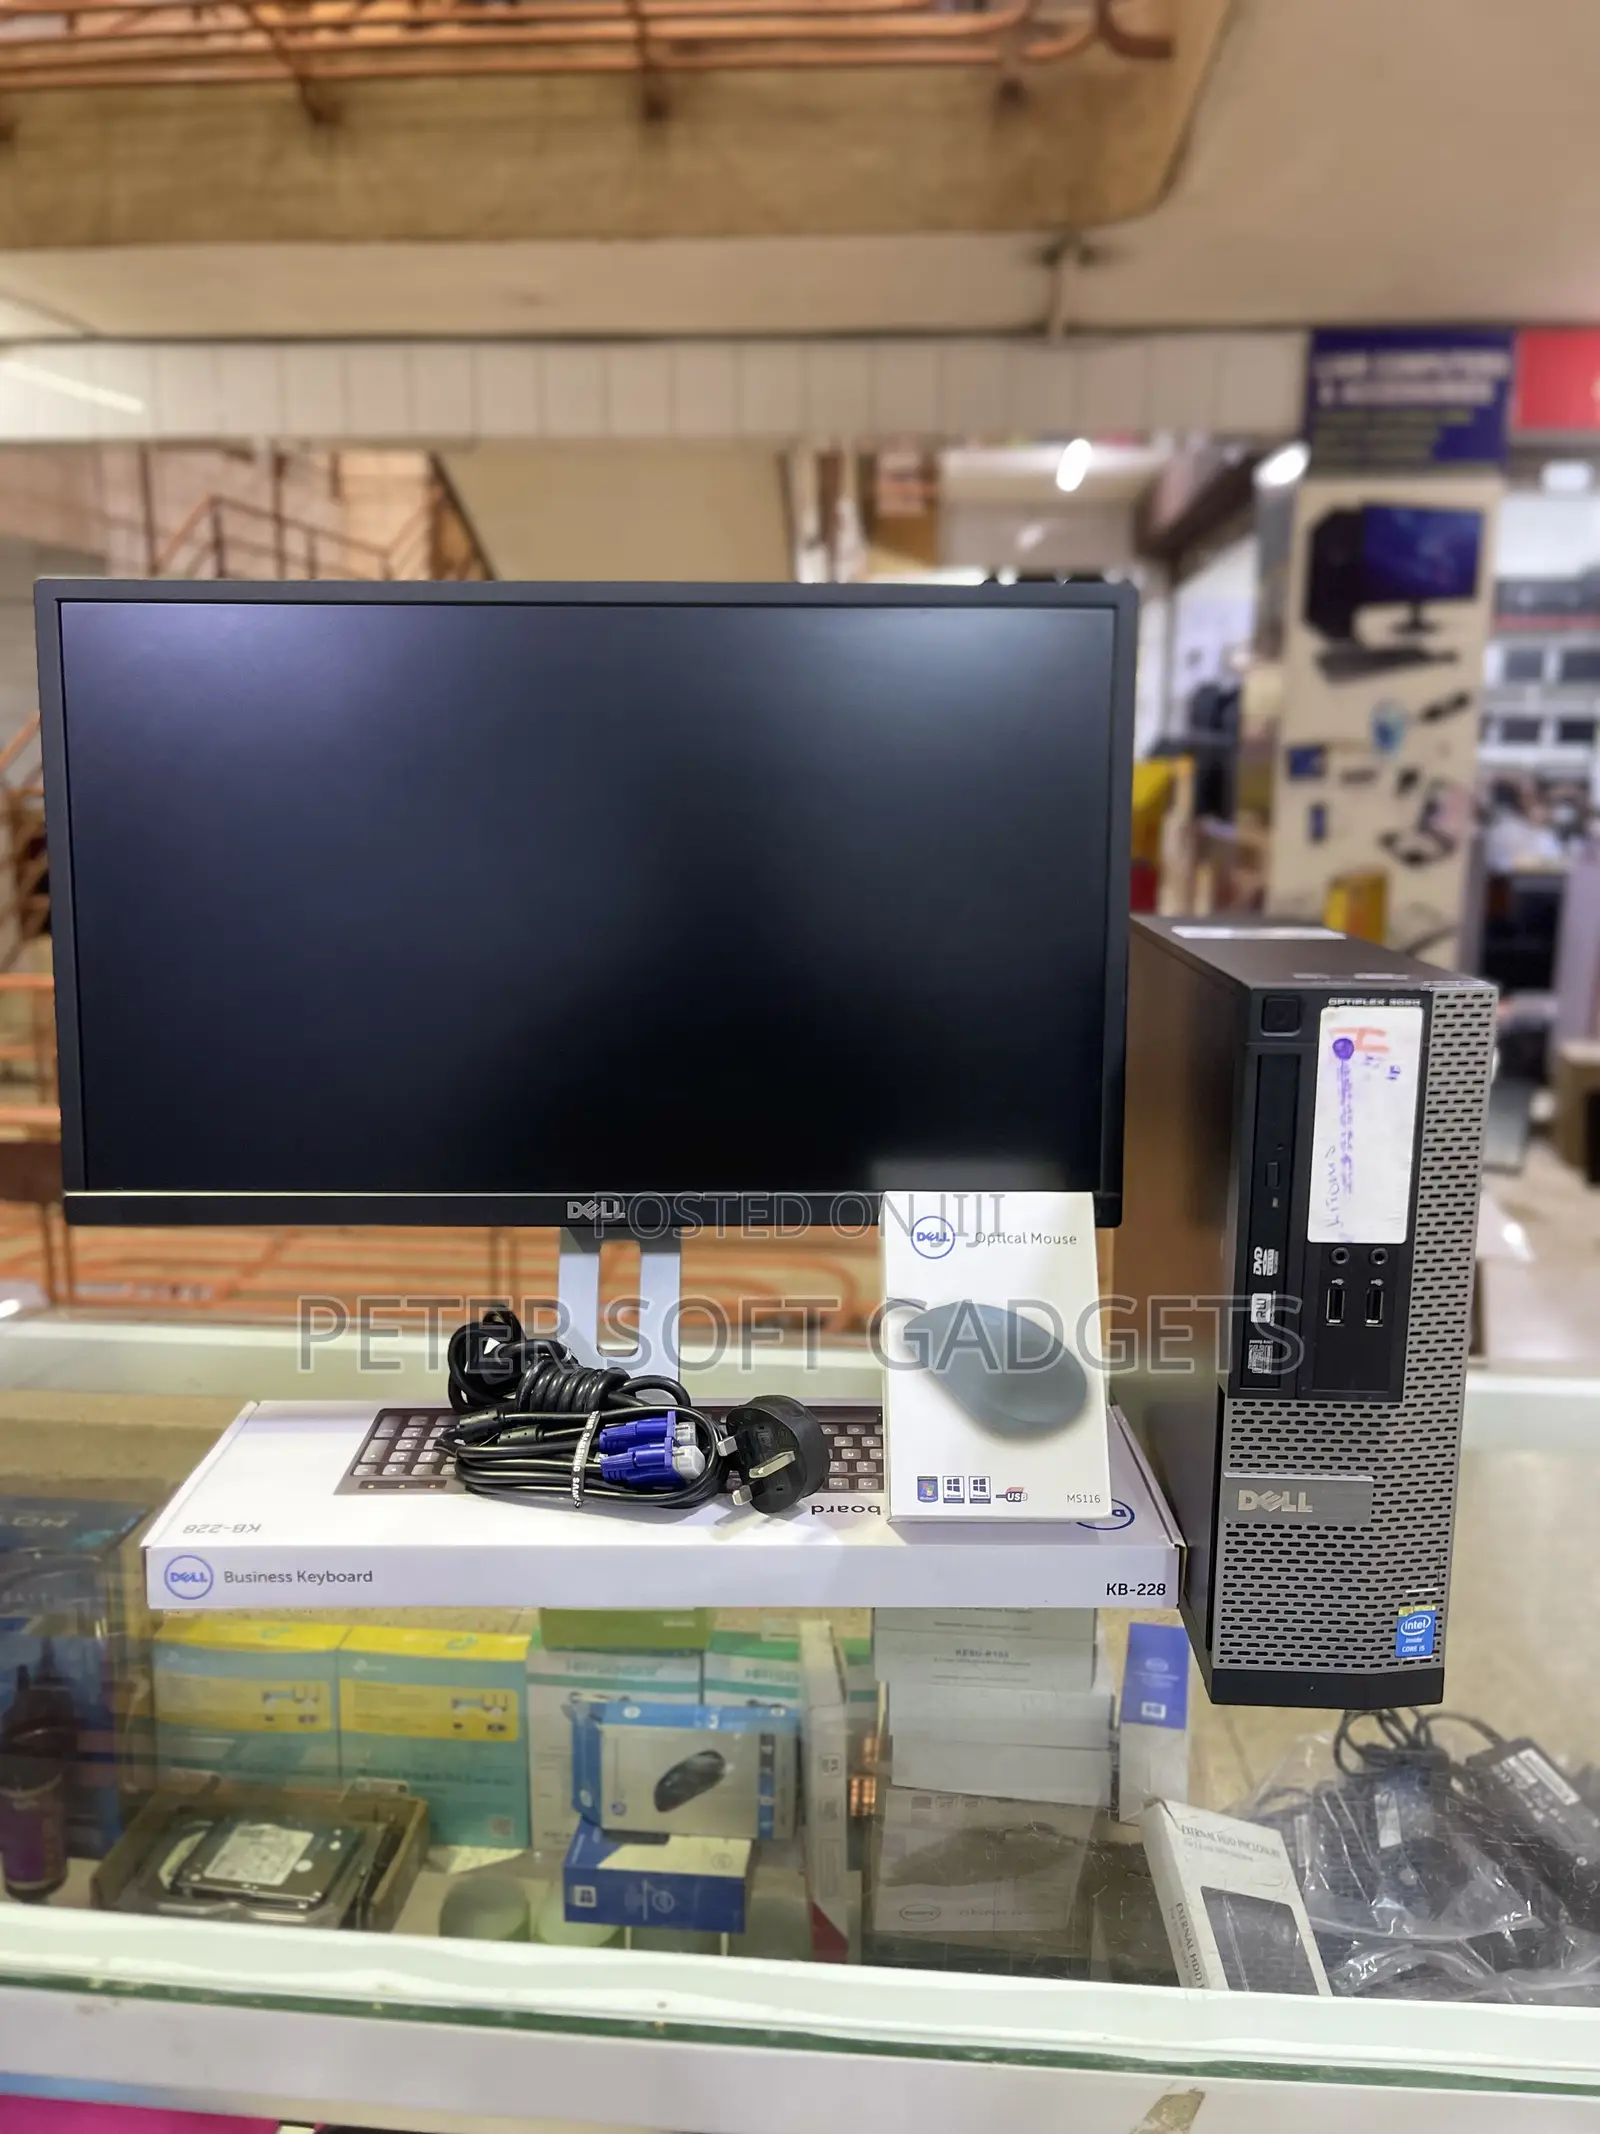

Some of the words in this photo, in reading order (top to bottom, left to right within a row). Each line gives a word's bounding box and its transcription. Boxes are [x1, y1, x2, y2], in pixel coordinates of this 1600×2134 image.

[566, 1200, 626, 1221] DELL
[916, 1231, 951, 1243] DELL
[975, 1231, 1027, 1248] Optical
[1030, 1232, 1077, 1246] Mouse
[1252, 1246, 1263, 1275] DVD
[573, 1432, 591, 1473] SAMSUNG
[1007, 1491, 1028, 1502] USB
[1066, 1493, 1101, 1504] MS116
[1237, 1489, 1314, 1513] DELL
[182, 1523, 262, 1535] KB-228
[169, 1571, 208, 1583] DELL
[223, 1570, 293, 1584] Business
[297, 1570, 374, 1586] Keyboard
[1106, 1582, 1167, 1596] KB-228
[1404, 1618, 1427, 1630] intel
[1401, 1644, 1418, 1653] CORE
